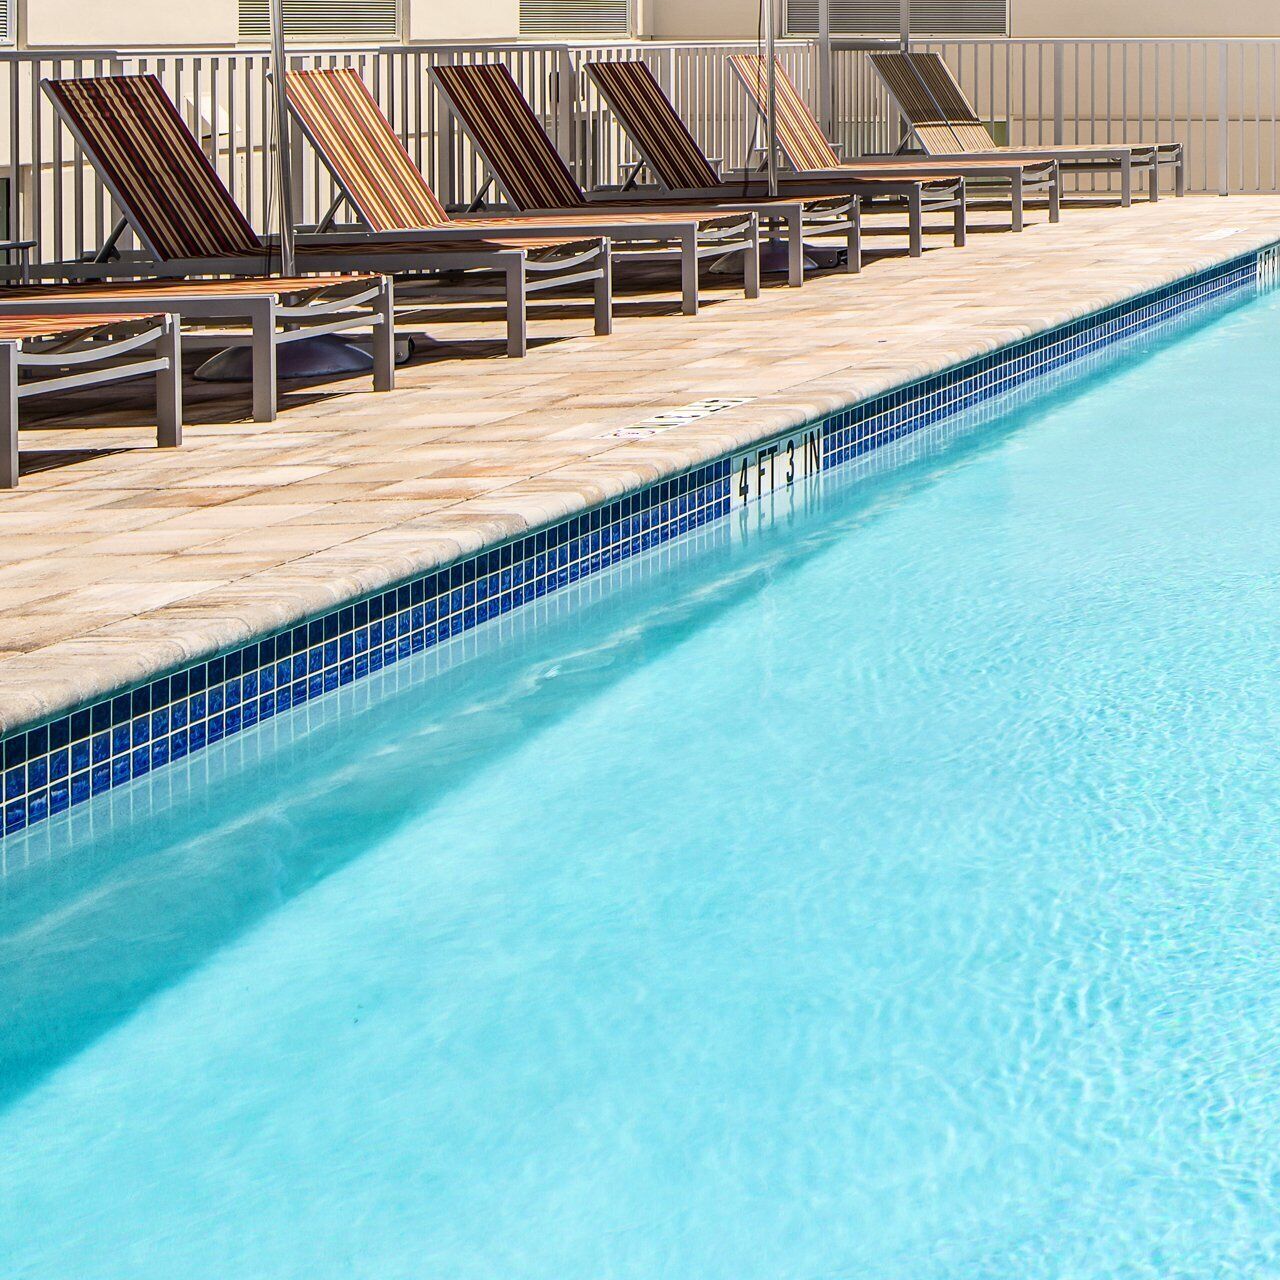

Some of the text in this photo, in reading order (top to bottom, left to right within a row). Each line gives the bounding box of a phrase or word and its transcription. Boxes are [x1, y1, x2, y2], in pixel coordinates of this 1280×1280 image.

[739, 428, 820, 506] 4 FT 3 IN
